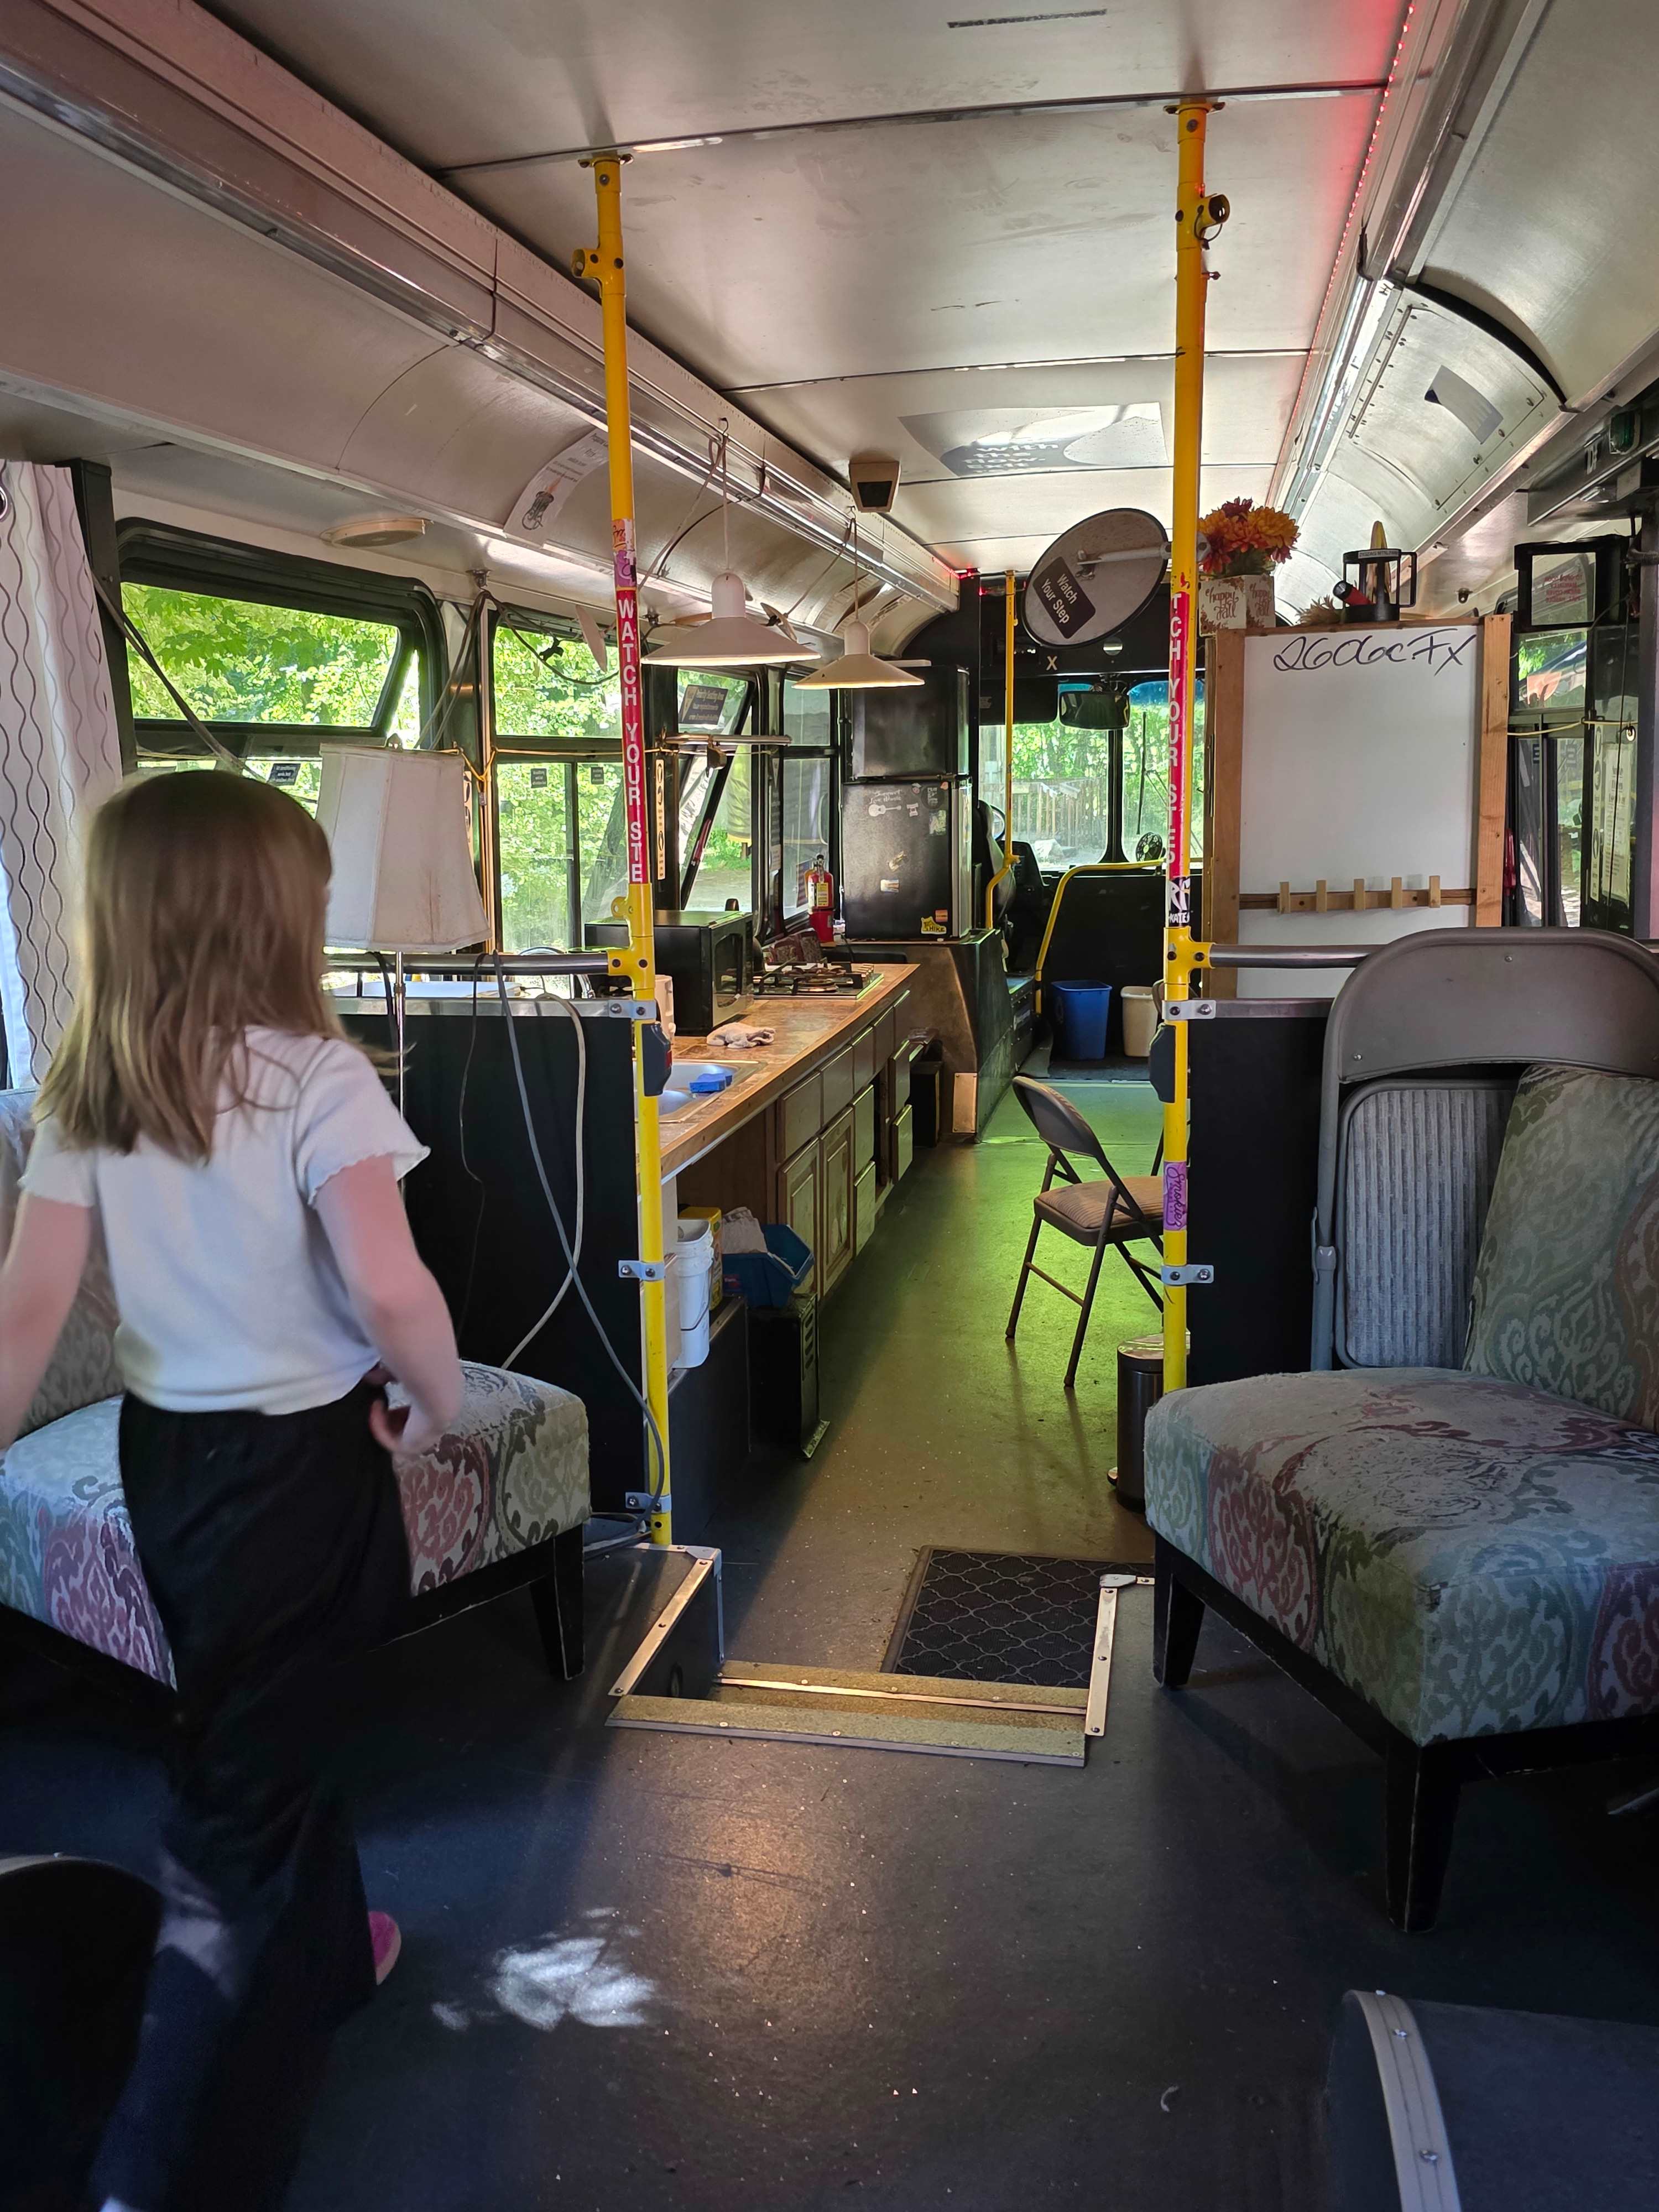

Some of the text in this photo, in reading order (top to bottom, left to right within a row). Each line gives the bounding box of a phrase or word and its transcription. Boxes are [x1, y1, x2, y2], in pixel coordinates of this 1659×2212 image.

[1041, 578, 1070, 624] Your Step
[1057, 573, 1077, 604] Watch
[618, 599, 637, 706] WATCH
[1046, 656, 1057, 670] X
[1168, 678, 1180, 766] YOUR
[626, 723, 641, 806] YOUR
